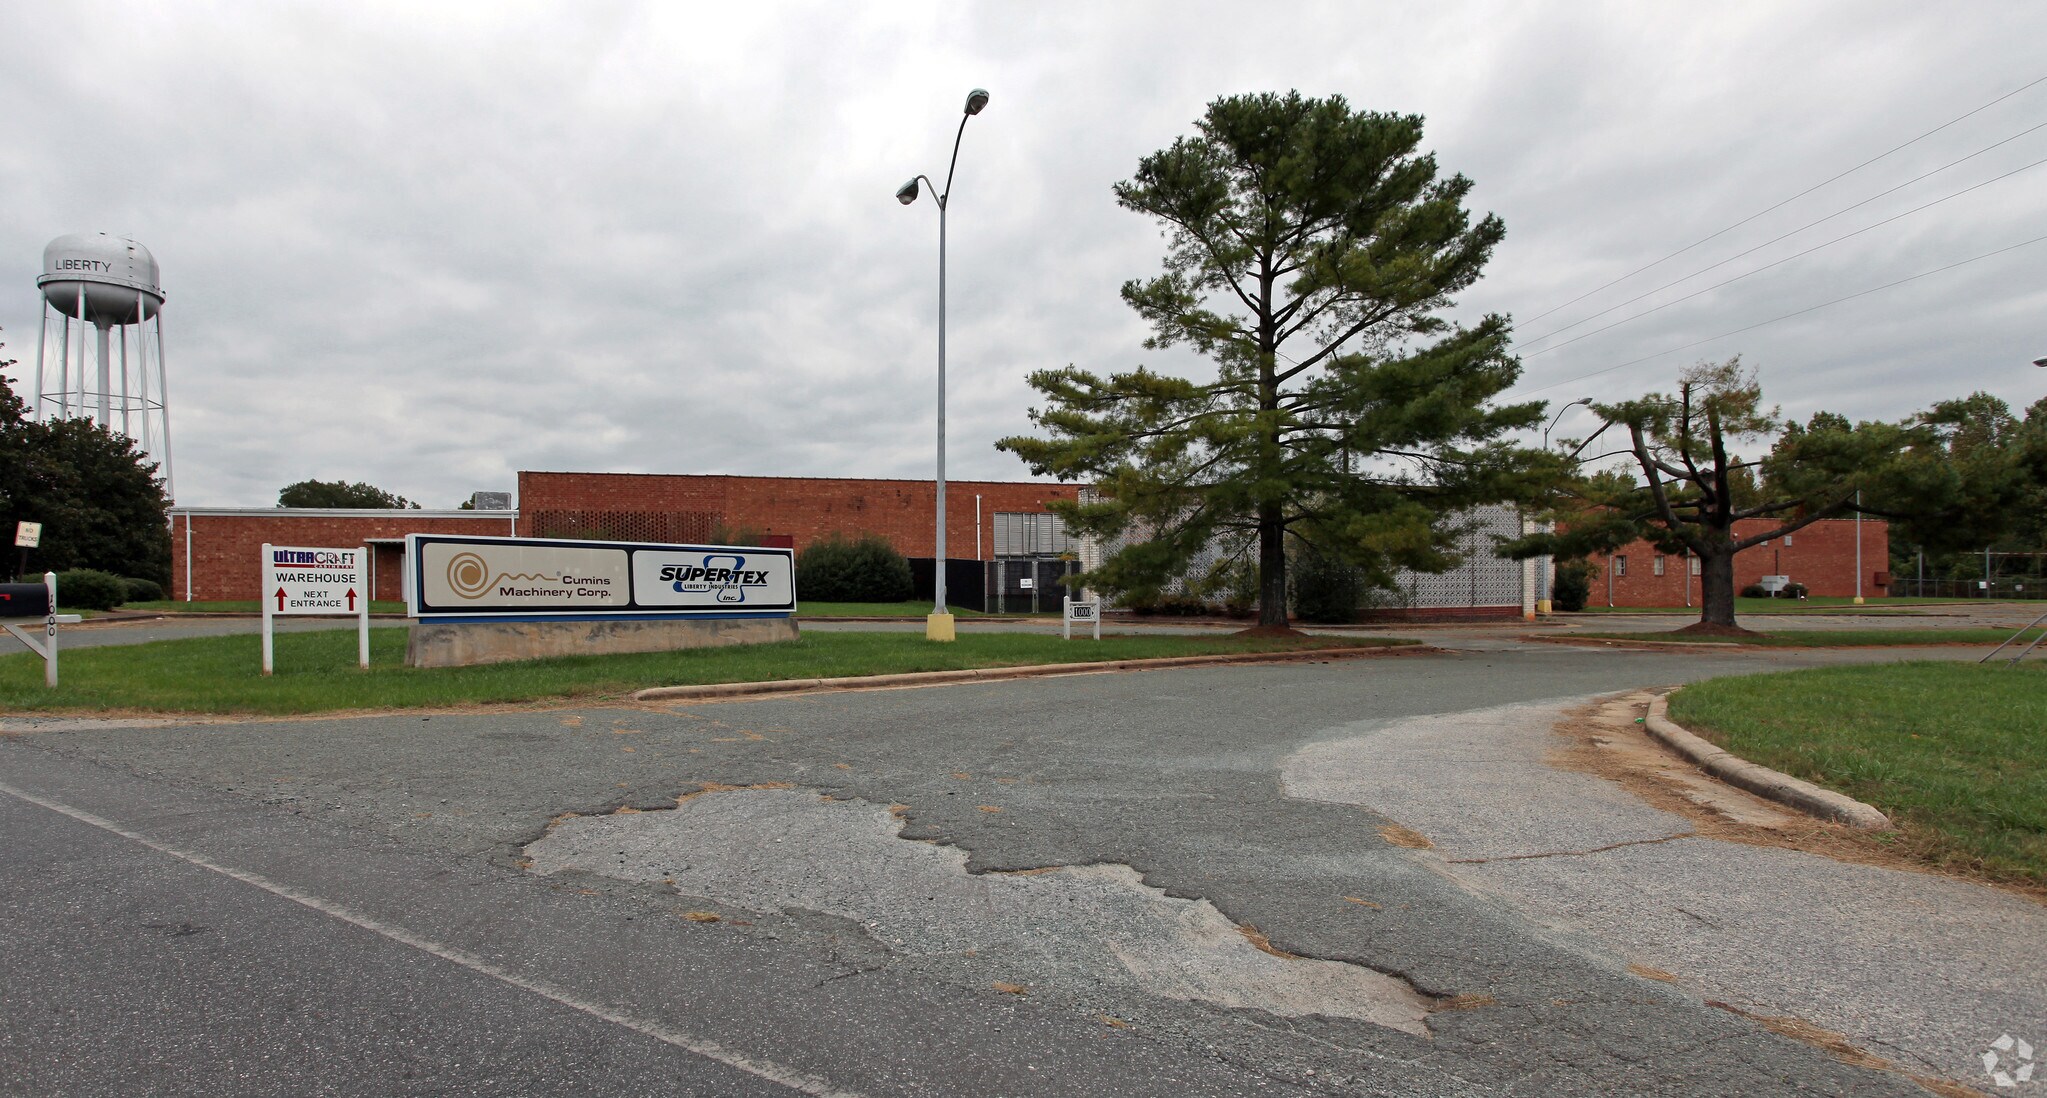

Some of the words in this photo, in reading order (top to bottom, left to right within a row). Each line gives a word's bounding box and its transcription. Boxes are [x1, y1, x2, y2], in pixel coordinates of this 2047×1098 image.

[56, 259, 111, 272] LIBERTY
[276, 573, 356, 583] WAREHOUSE
[562, 576, 611, 585] Cumins
[660, 567, 769, 584] SUPERTEX
[500, 587, 573, 598] Machinery
[577, 588, 611, 598] Corp.
[48, 594, 56, 637] 1000
[1075, 607, 1091, 617] 1000
